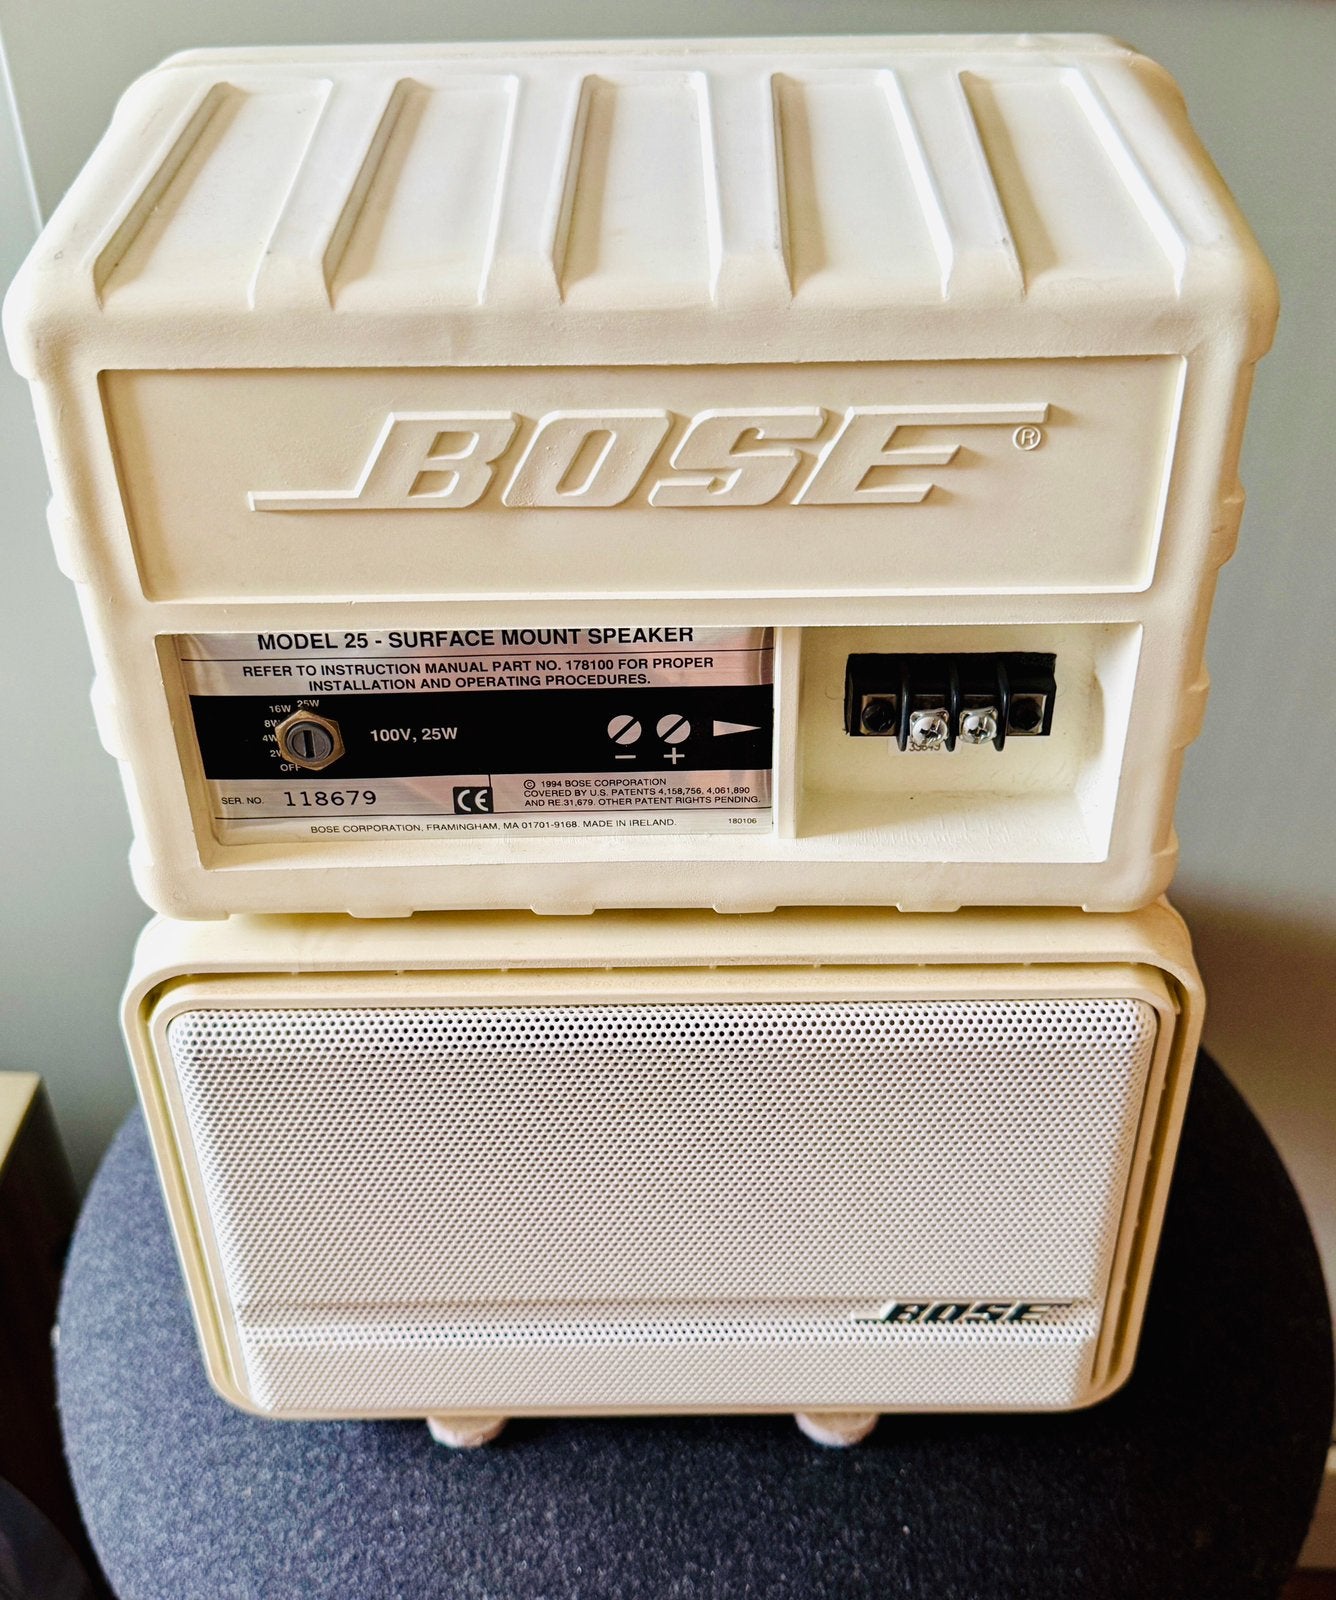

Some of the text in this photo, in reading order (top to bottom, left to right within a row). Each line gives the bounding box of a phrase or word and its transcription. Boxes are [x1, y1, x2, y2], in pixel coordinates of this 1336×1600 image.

[248, 402, 1051, 511] BOSE
[257, 633, 338, 650] MODEL
[344, 633, 368, 649] 25
[388, 630, 495, 648] SURFACE
[502, 629, 582, 646] MOUNT
[588, 627, 693, 645] SPEAKER
[242, 657, 714, 677] REFER TO INSTRUCTION MANUAL PART NO. 178100 FOR PROPER
[309, 673, 651, 692] INSTALLATION AND OPERATING PROCEDURES.
[269, 705, 291, 713] 16W
[297, 700, 319, 708] 25W
[370, 727, 458, 743] 100V, 25W
[541, 780, 562, 788] 1994
[565, 779, 592, 787] BOSE
[594, 778, 667, 787] CORPORATION
[221, 790, 377, 807] SER. NO. 118679
[524, 789, 572, 798] COVERED
[574, 789, 587, 797] BY
[589, 788, 608, 797] U.S.
[611, 787, 656, 796] PATENTS
[706, 786, 750, 796] 4,061,890
[524, 799, 545, 807] AND
[598, 797, 632, 806] OTHER
[634, 797, 673, 805] PATENT
[675, 796, 712, 804] RIGHTS
[714, 795, 760, 804] PENDING.
[311, 825, 340, 833] BOSE
[503, 822, 519, 830] MA
[583, 820, 613, 828] MADE
[616, 819, 626, 827] IN
[629, 818, 677, 827] IRELAND.
[728, 817, 757, 825] 180106
[850, 1299, 1073, 1322] BOSE
